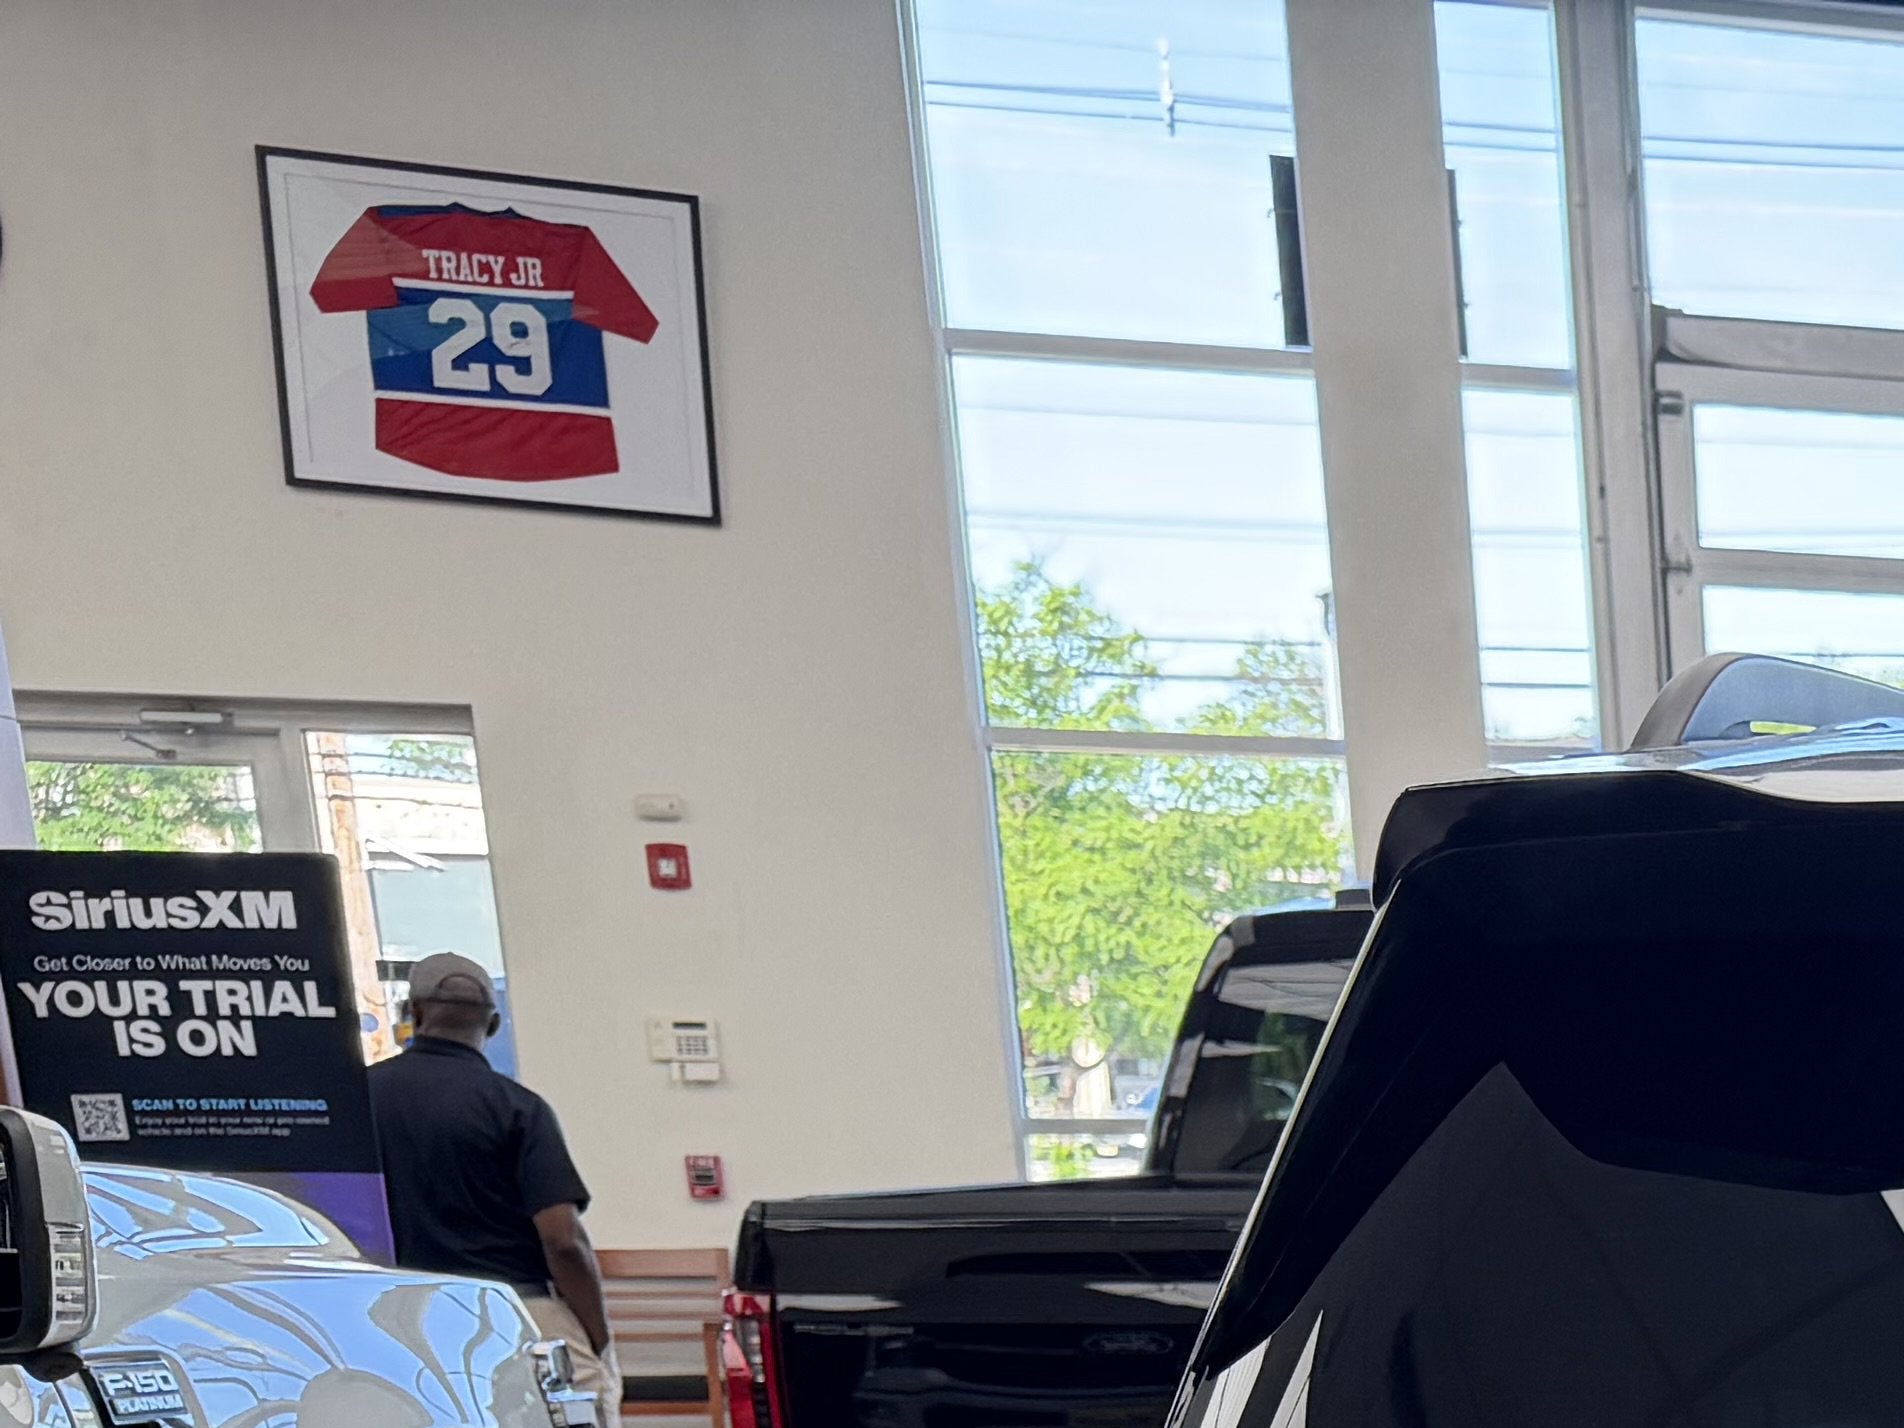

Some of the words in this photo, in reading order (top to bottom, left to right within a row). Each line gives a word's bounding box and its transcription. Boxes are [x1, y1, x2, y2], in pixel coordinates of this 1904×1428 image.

[422, 248, 505, 285] TRACY
[509, 256, 545, 287] JR
[428, 297, 553, 396] 29
[29, 890, 297, 931] SiriusXM
[34, 955, 69, 972] Get
[72, 955, 131, 971] Closer
[136, 955, 155, 971] to
[158, 954, 208, 971] What
[211, 955, 271, 971] Moves
[274, 955, 310, 971] You
[17, 981, 172, 1018] YOUR
[179, 980, 336, 1018] TRIAL
[114, 1020, 166, 1057] IS
[176, 1019, 257, 1057] ON
[132, 1099, 174, 1111] SCAN
[176, 1099, 197, 1110] TO
[200, 1099, 246, 1110] START
[102, 1370, 179, 1397] F-150
[114, 1394, 184, 1415] PLATINUM
